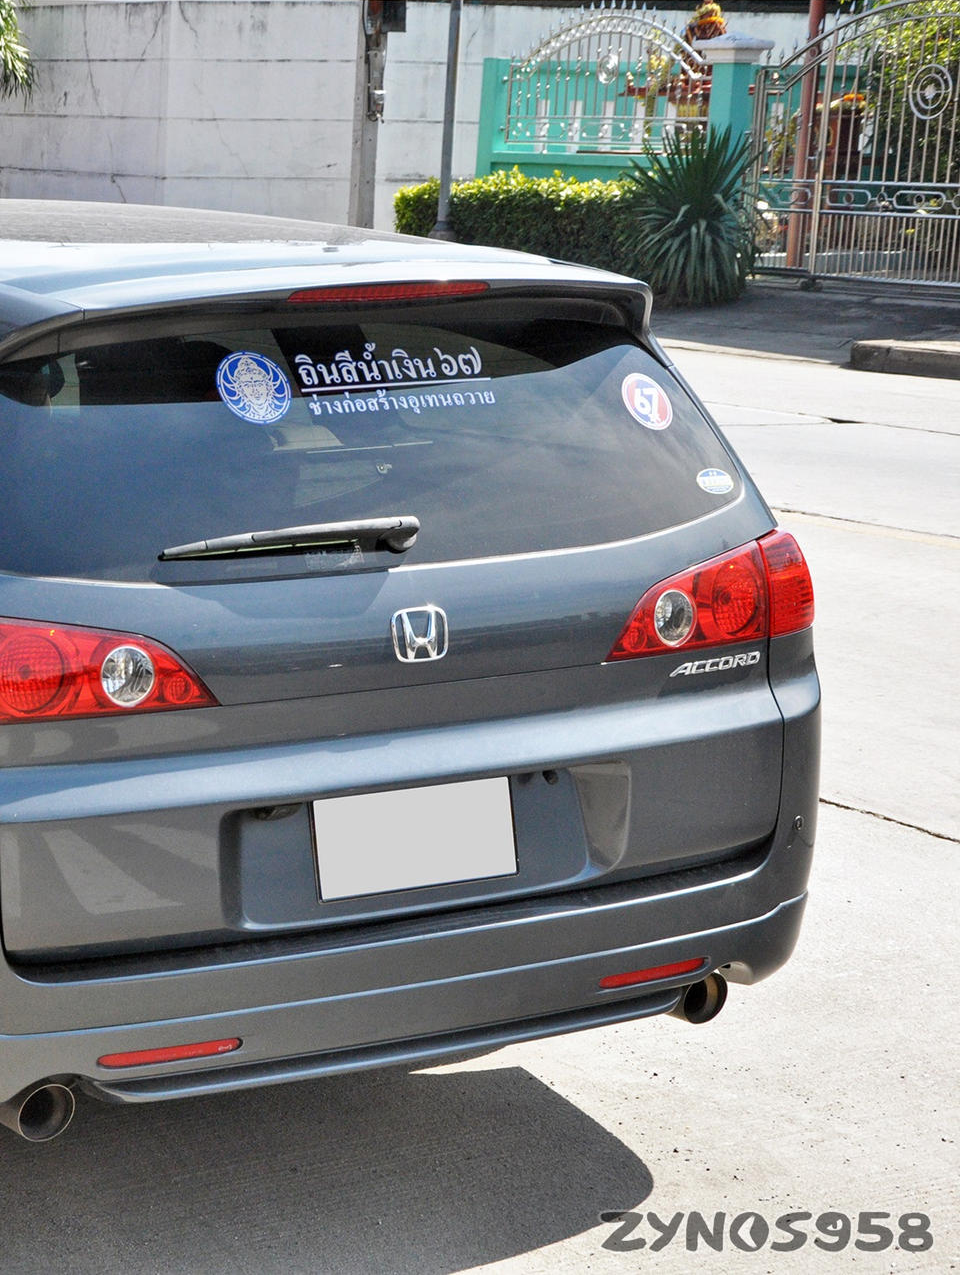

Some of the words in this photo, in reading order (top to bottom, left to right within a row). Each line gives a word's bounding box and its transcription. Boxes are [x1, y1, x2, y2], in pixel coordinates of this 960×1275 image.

[433, 346, 482, 376] ๖๗
[308, 389, 496, 416] ช่างก่อสร้างอุเทนถวาย
[634, 387, 659, 416] 67
[669, 651, 760, 677] ACCORD
